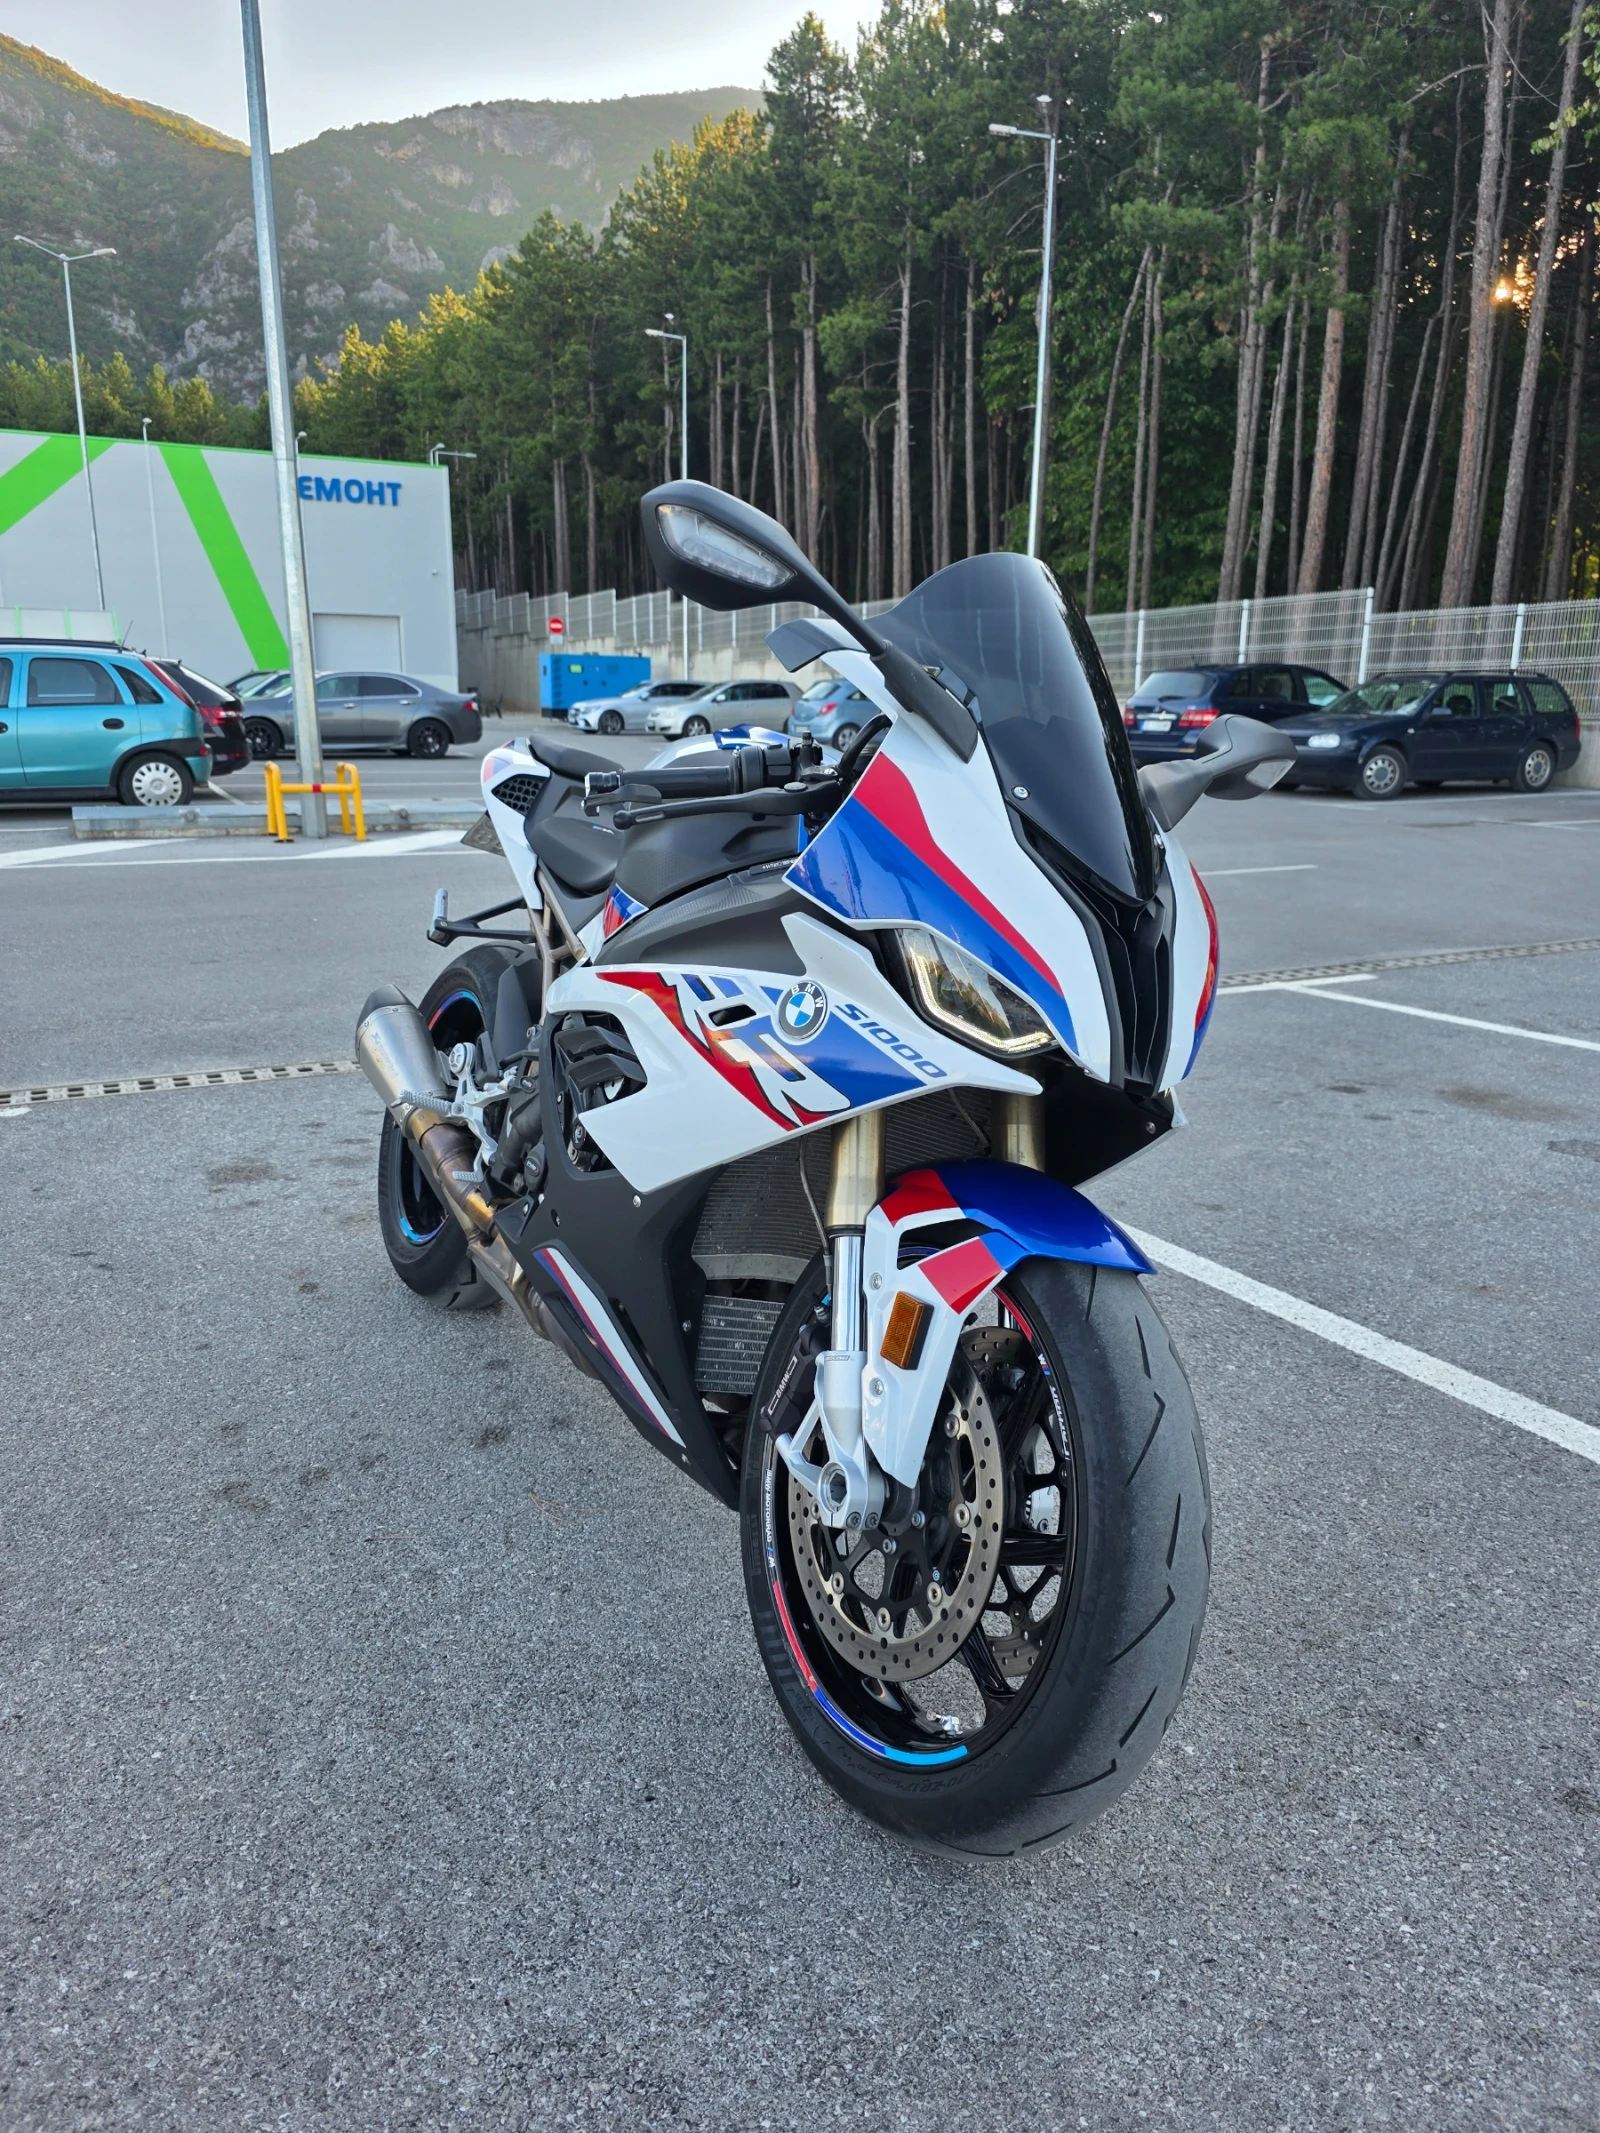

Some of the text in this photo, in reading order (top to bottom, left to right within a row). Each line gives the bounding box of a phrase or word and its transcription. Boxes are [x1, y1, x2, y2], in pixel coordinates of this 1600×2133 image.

[297, 475, 402, 506] ЕМОНТ
[791, 983, 824, 1008] BMW
[834, 1003, 948, 1078] S1000
[776, 1373, 790, 1398] BMW
[765, 1492, 773, 1543] MOTORRAD
